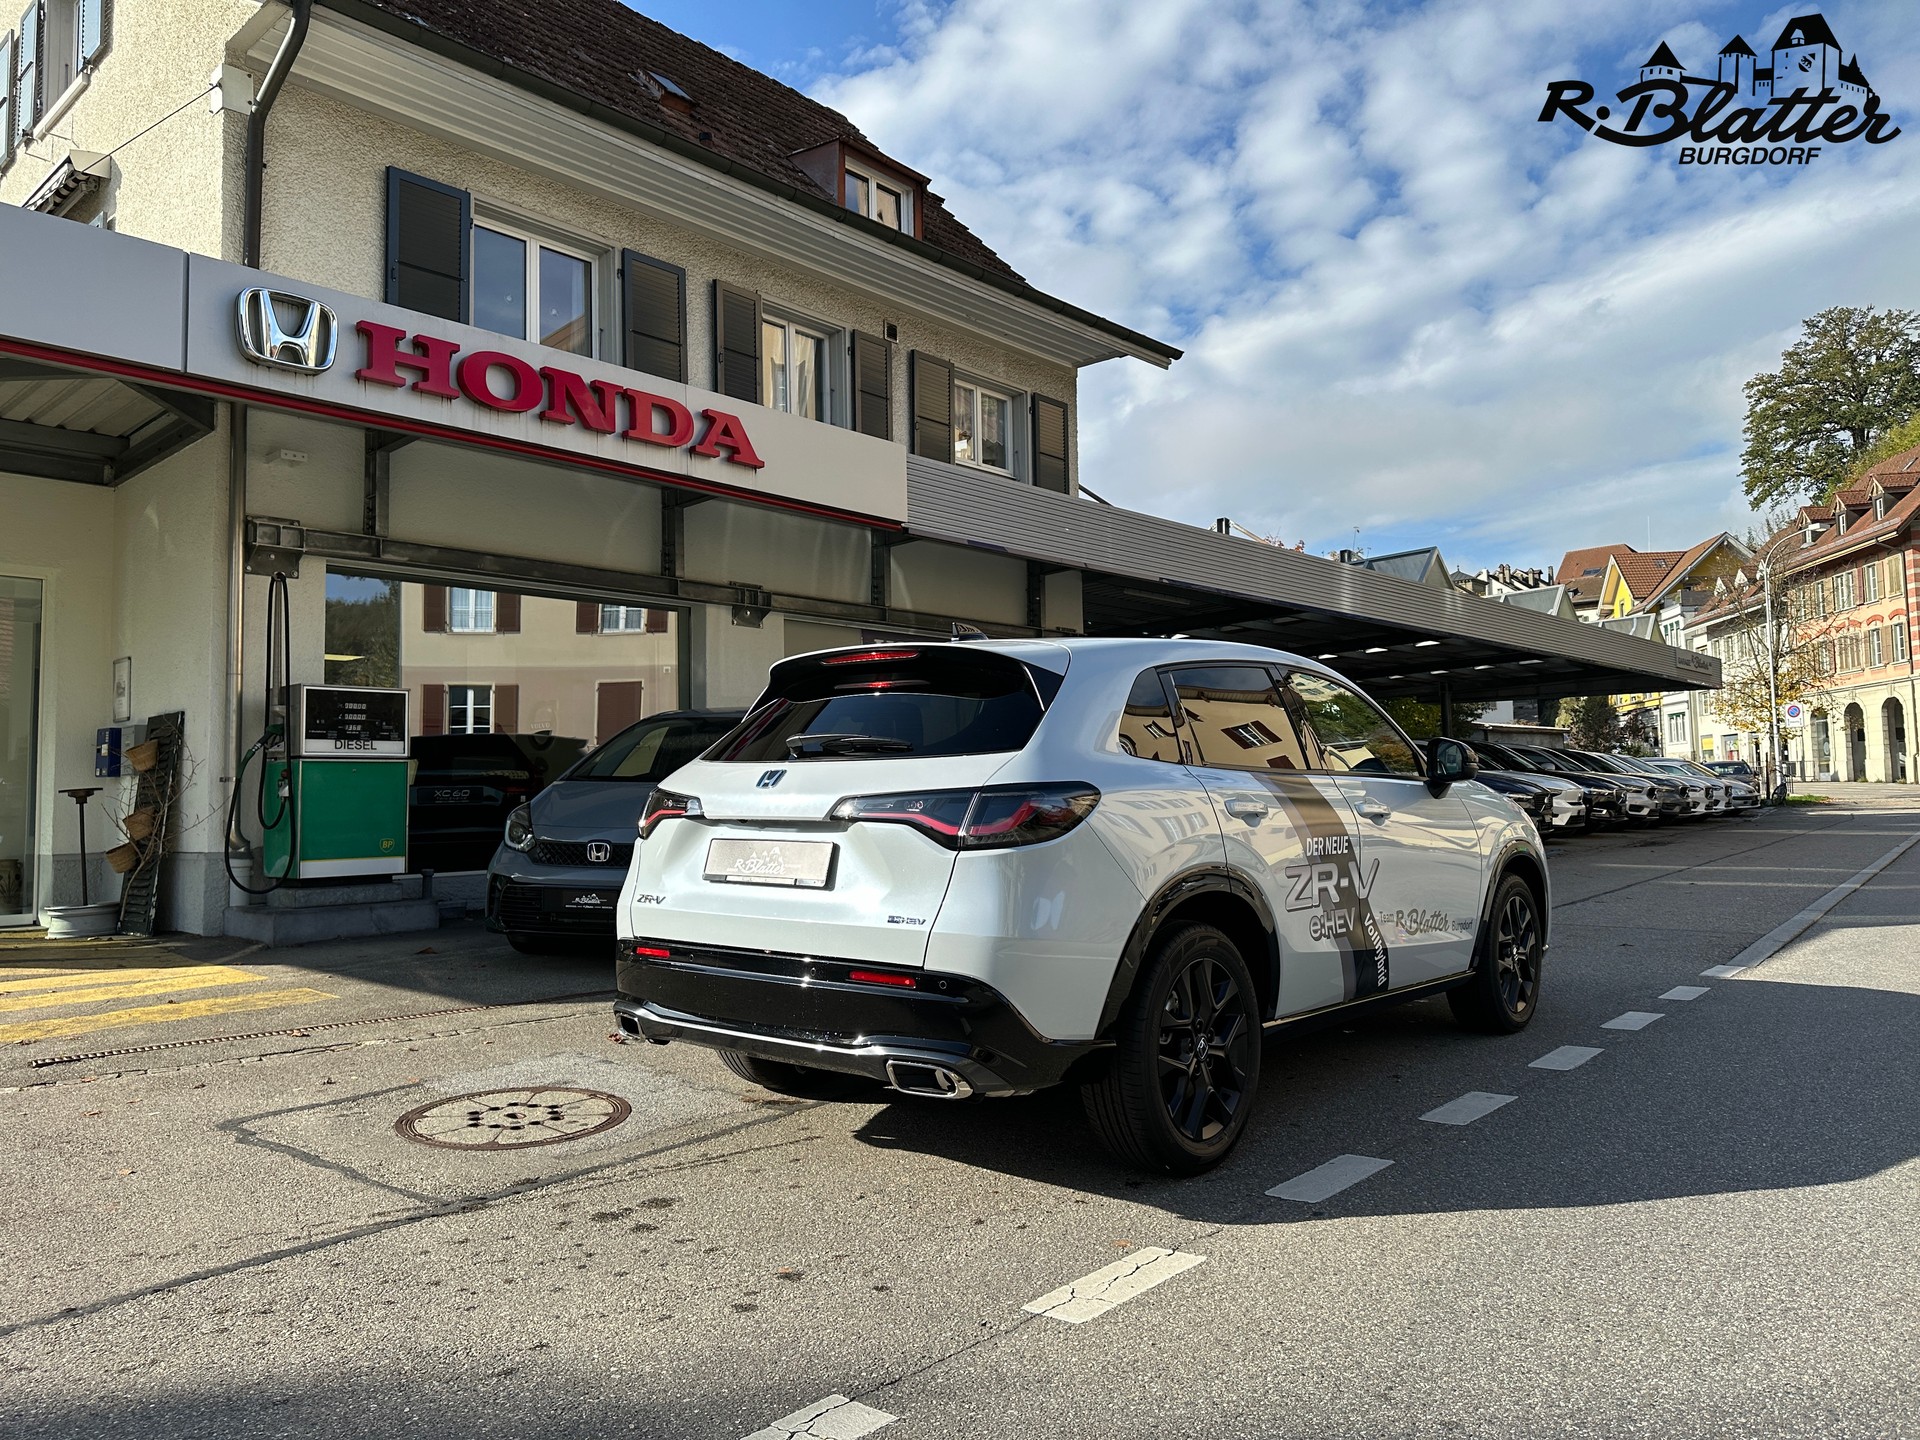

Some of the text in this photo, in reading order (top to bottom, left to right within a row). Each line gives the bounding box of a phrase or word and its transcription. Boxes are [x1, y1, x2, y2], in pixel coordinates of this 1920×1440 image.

[355, 320, 765, 469] HONDA
[335, 740, 377, 750] DIESEL
[382, 840, 393, 849] BP
[1306, 835, 1350, 857] DER NEUE
[1285, 858, 1380, 912] ZR-V
[1309, 906, 1357, 942] e:HEV
[1363, 912, 1388, 987] Vollhybrid
